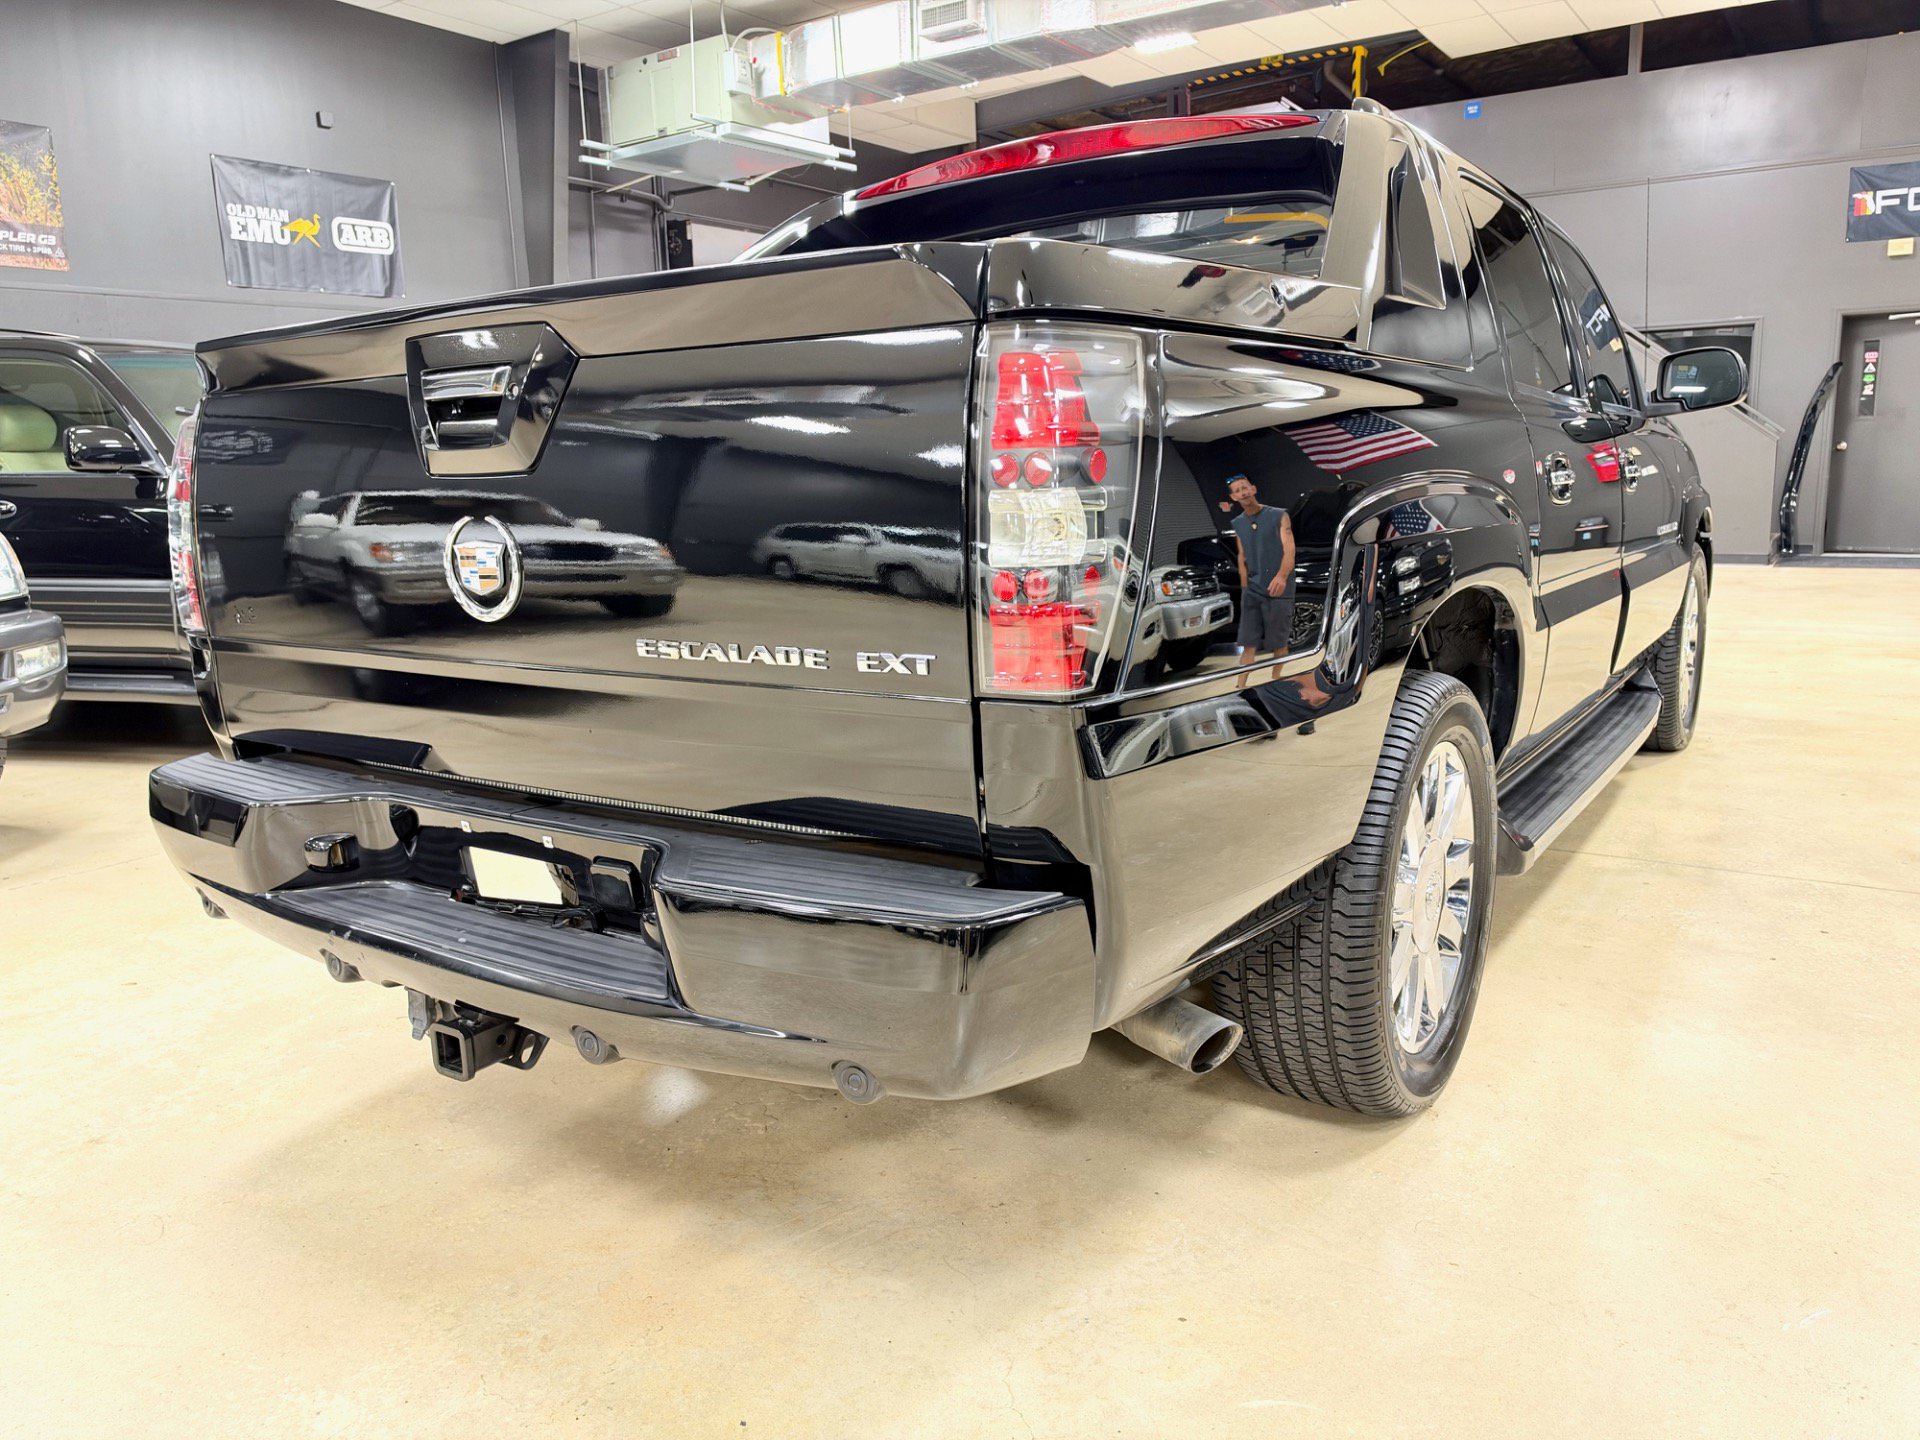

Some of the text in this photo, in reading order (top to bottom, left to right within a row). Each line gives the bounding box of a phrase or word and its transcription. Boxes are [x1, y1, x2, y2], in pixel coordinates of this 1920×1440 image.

[226, 203, 289, 222] OLD MAN
[0, 230, 36, 243] PLER
[228, 215, 291, 246] EMU
[339, 223, 391, 249] ARB
[635, 638, 937, 675] ESCALADE EXT
